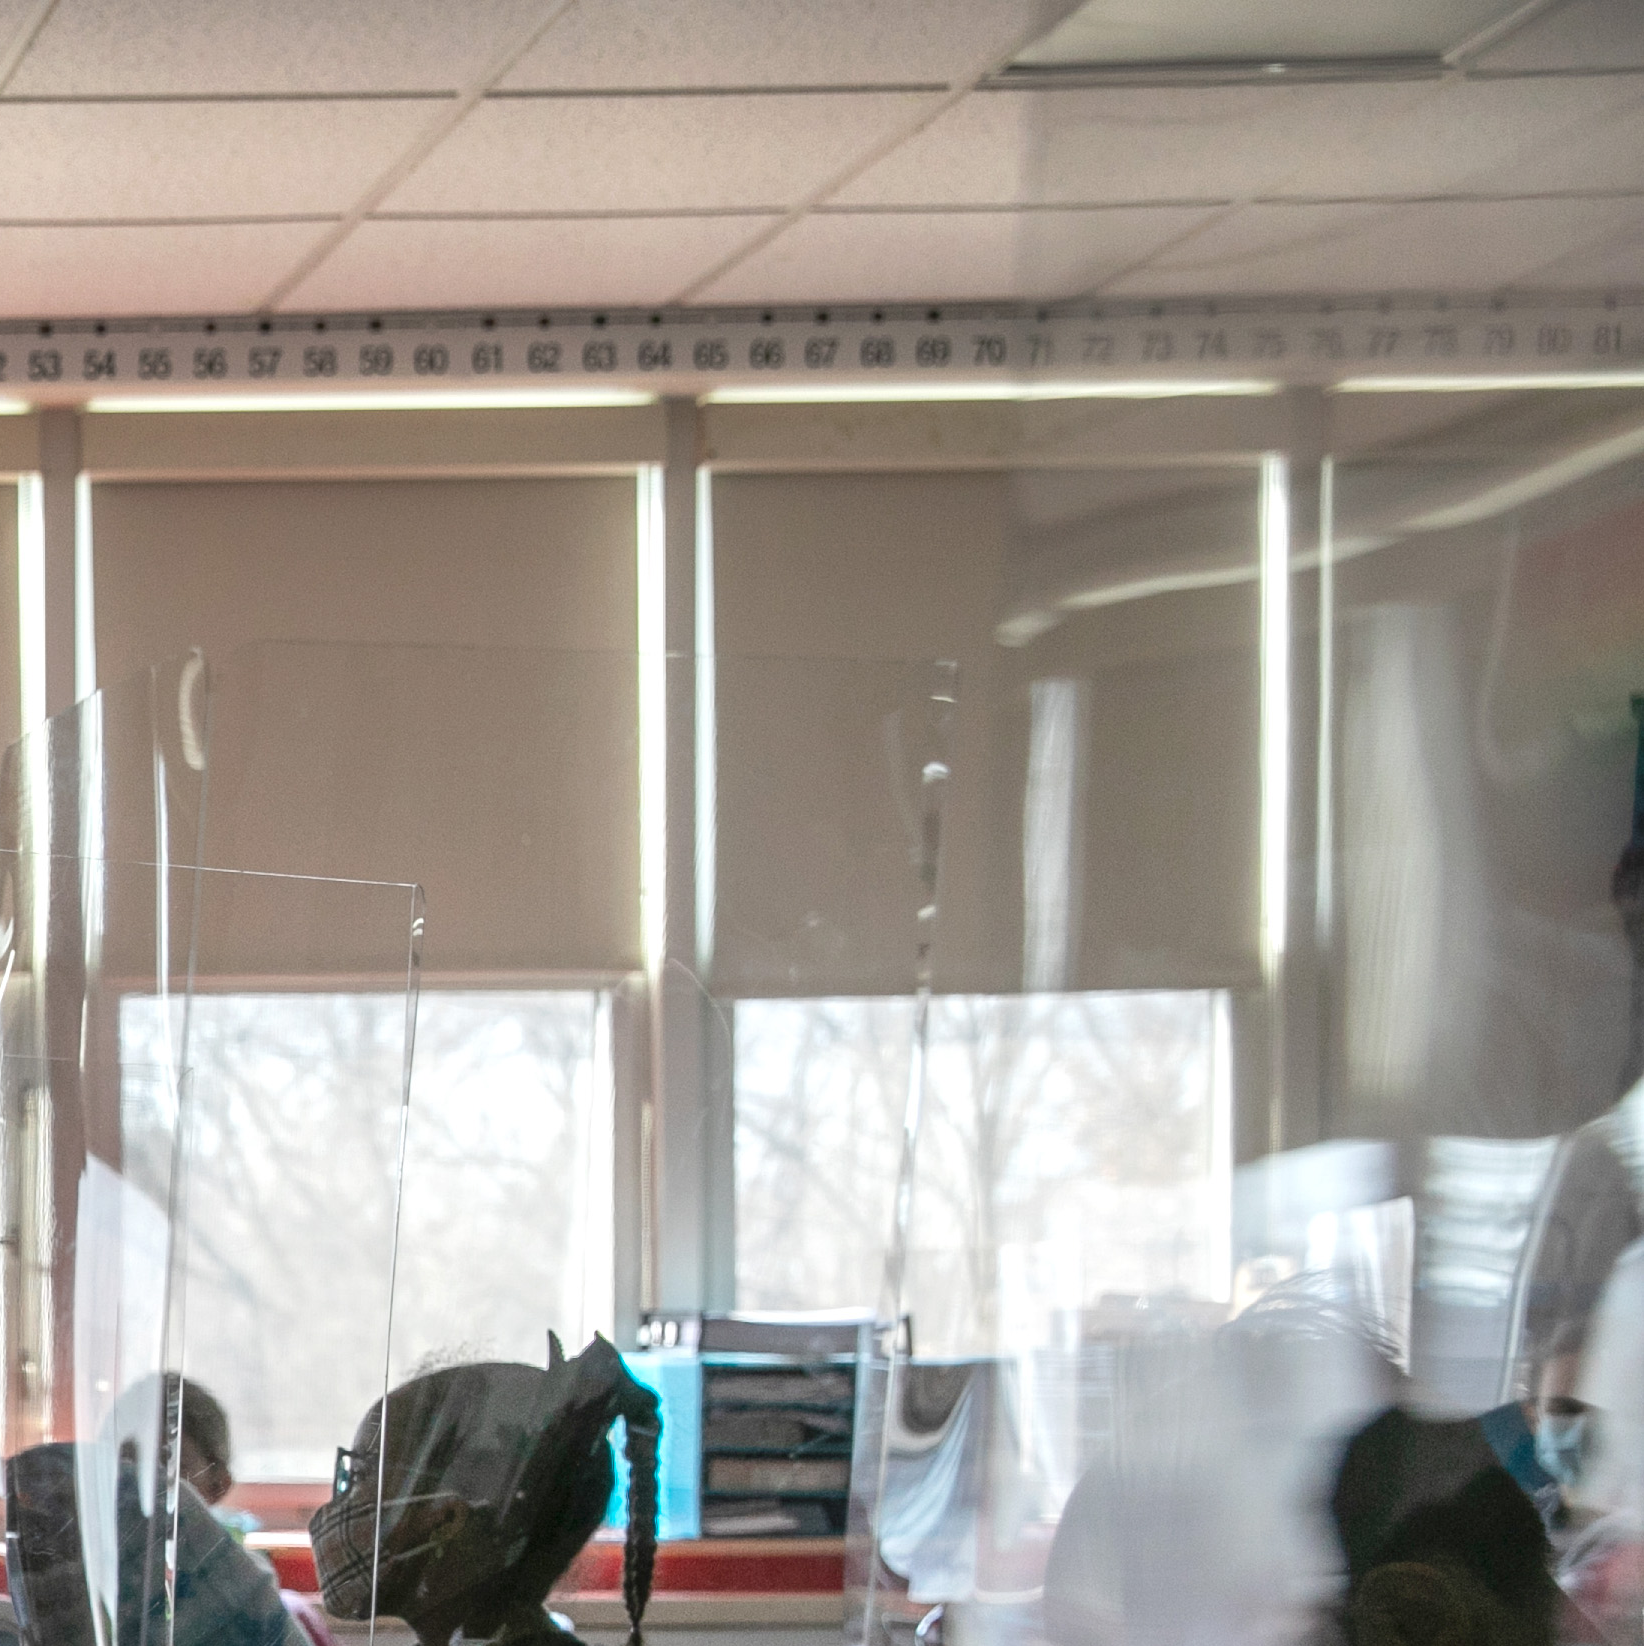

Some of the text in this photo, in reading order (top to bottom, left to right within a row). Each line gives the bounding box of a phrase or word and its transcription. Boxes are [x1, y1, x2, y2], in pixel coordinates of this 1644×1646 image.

[28, 350, 63, 382] 53
[84, 350, 116, 380] 54
[139, 349, 172, 380] 55
[194, 349, 227, 379] 56
[248, 347, 282, 379] 57
[304, 346, 338, 377] 58
[360, 345, 394, 376] 59
[414, 345, 449, 375] 60
[471, 343, 503, 374] 61
[527, 343, 562, 373] 62
[582, 341, 618, 372] 63
[638, 342, 672, 371] 64
[693, 340, 729, 371] 65
[749, 340, 784, 369] 66
[804, 337, 839, 369] 67
[860, 338, 896, 367] 68
[916, 337, 951, 367] 69
[974, 336, 1007, 366] 70
